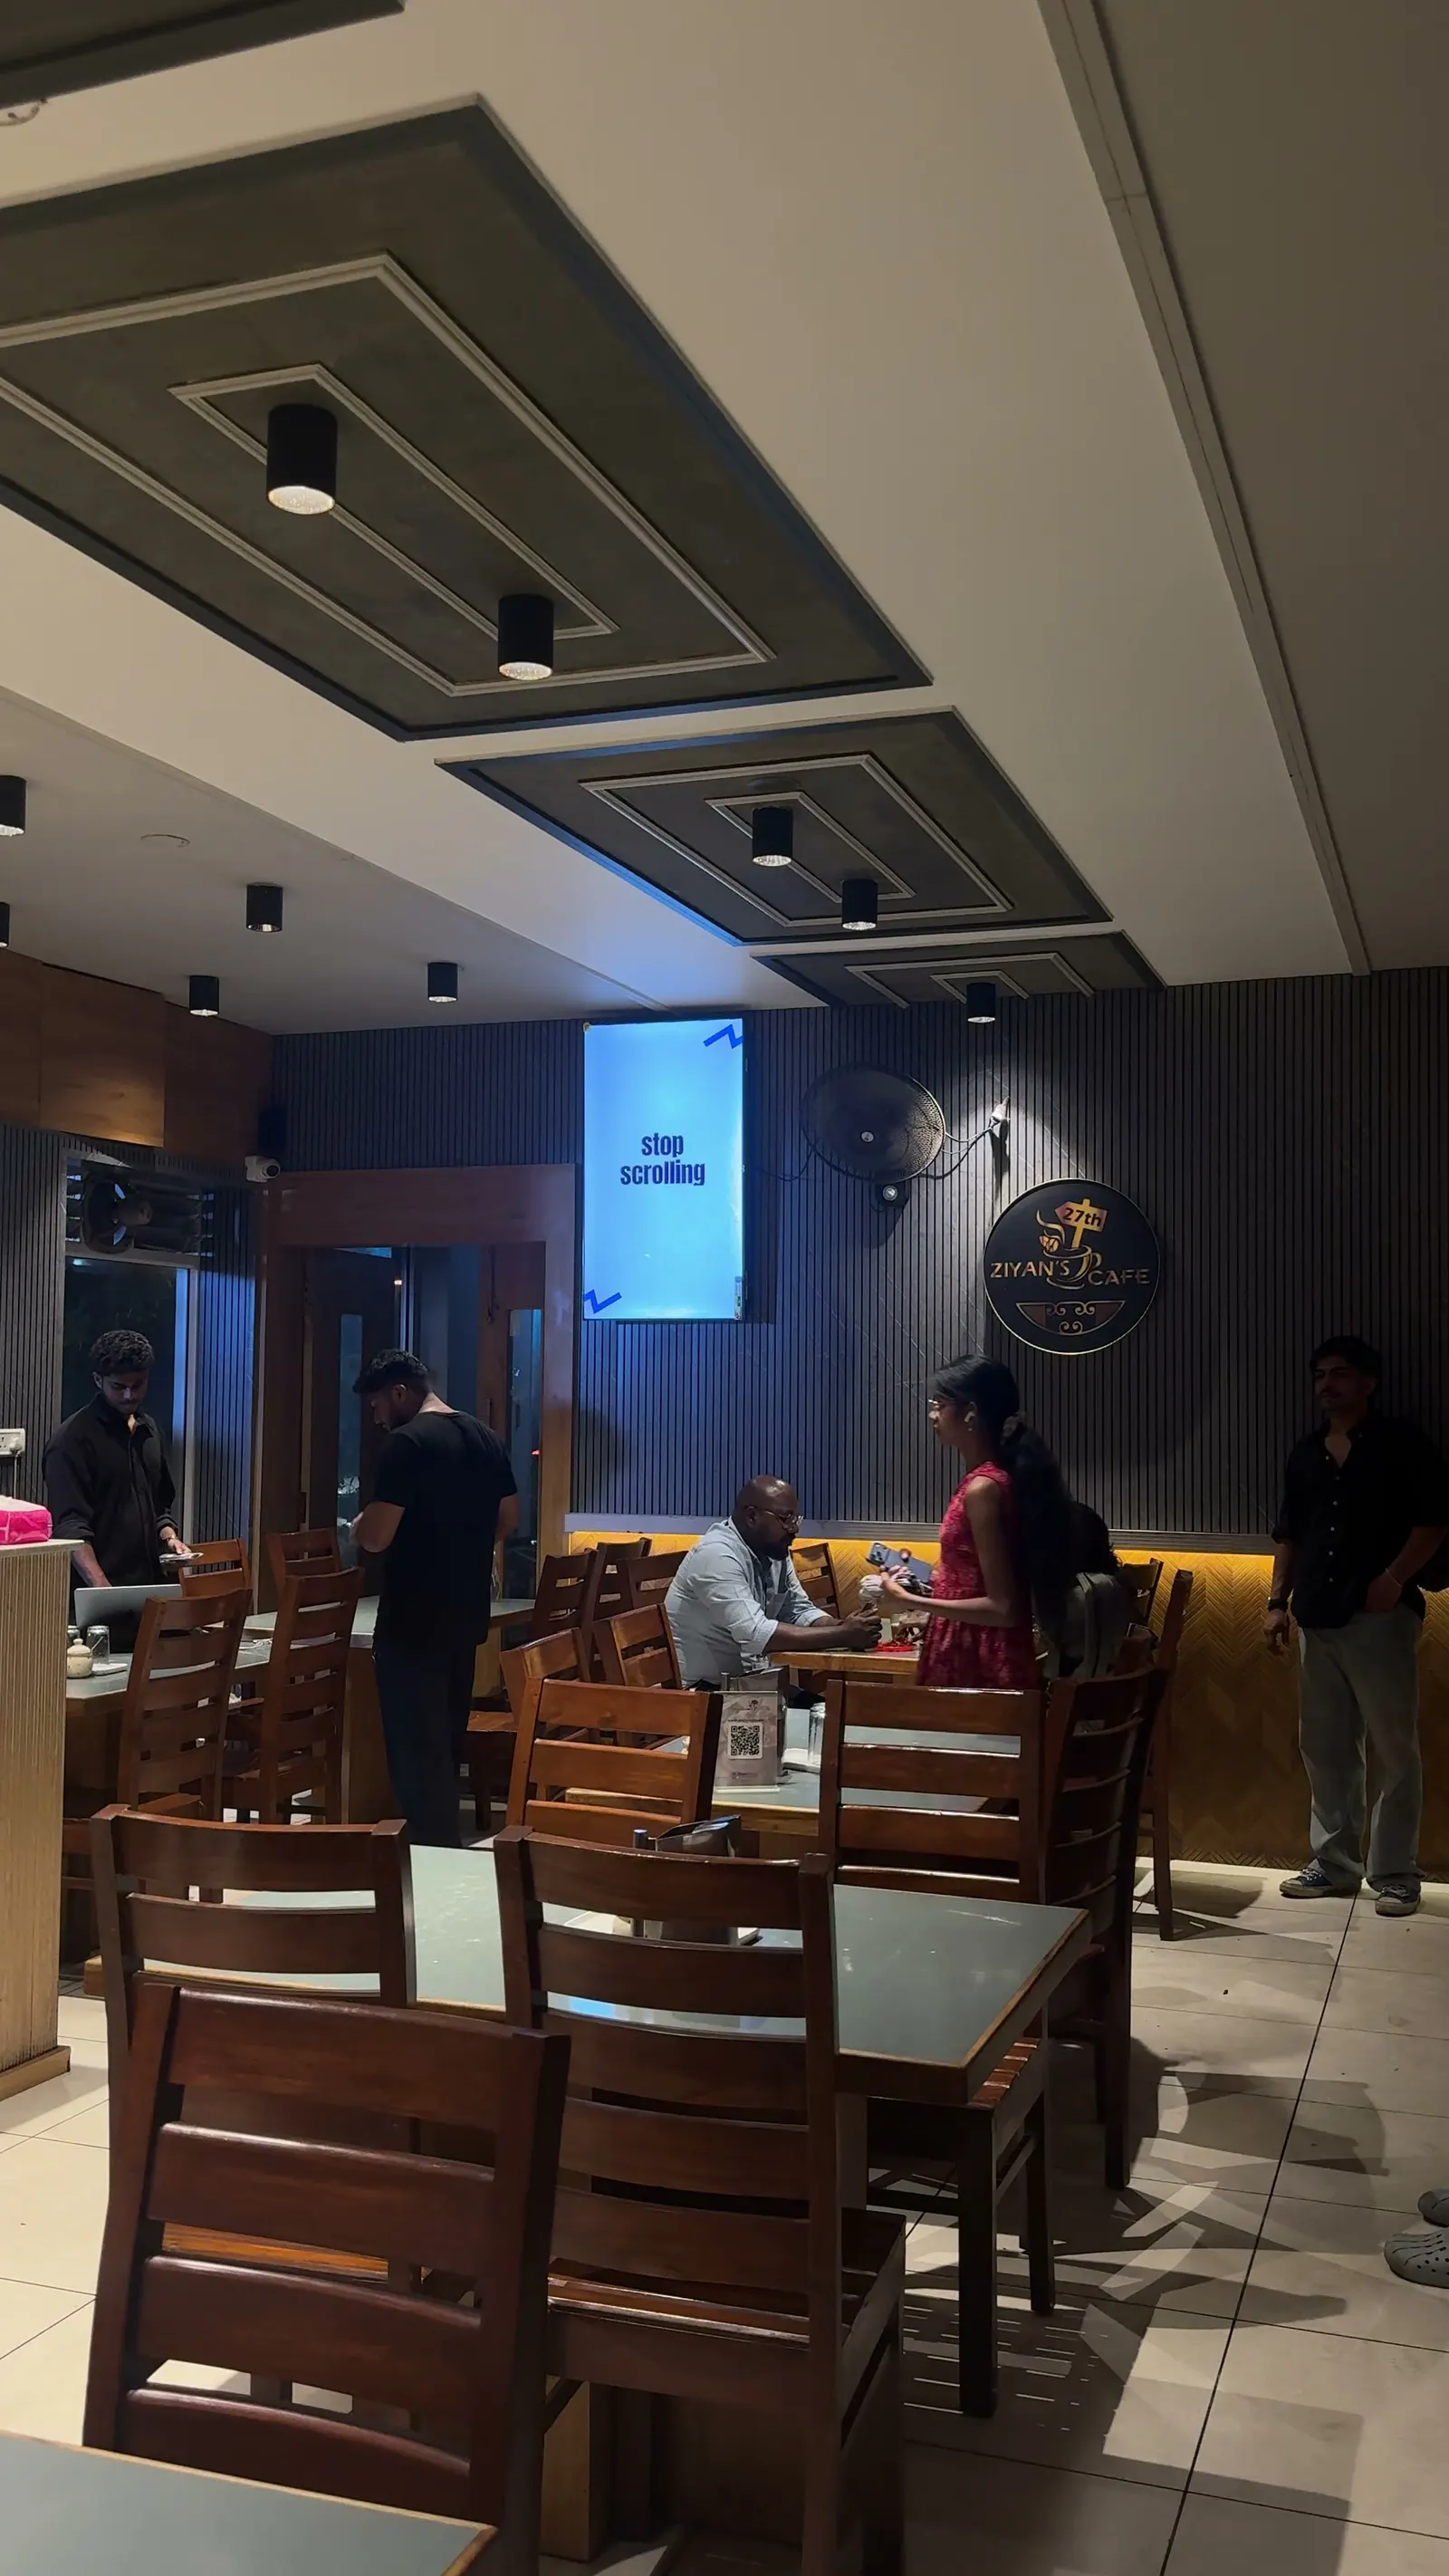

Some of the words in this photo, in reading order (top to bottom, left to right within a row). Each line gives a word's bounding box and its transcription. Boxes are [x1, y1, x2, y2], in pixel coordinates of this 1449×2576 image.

[641, 1132, 684, 1158] stop
[620, 1159, 705, 1186] scrolling
[1063, 1207, 1101, 1226] 27th
[990, 1260, 1070, 1277] ZIYAN'S
[1088, 1269, 1150, 1285] CAFE
